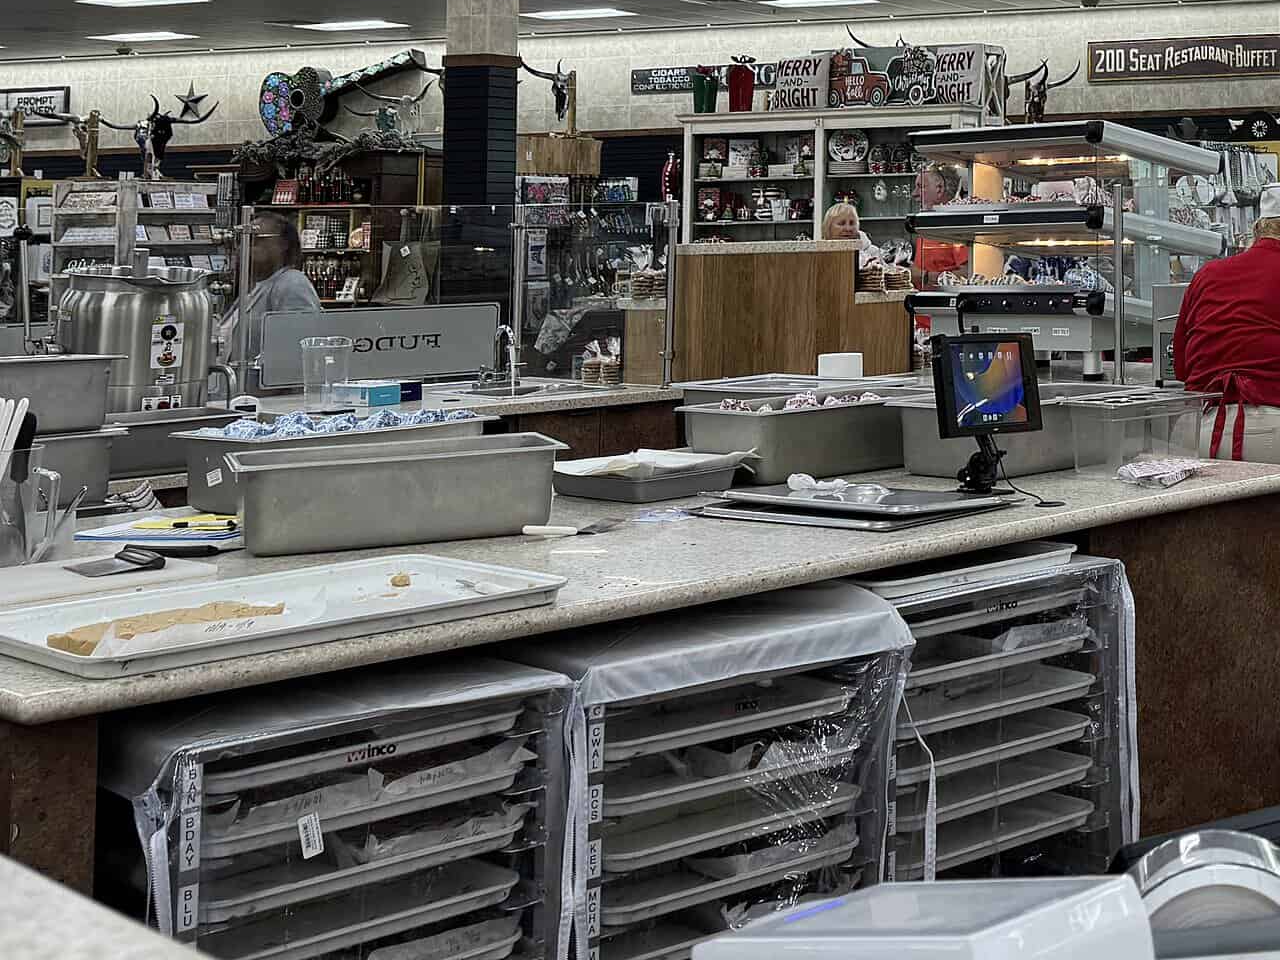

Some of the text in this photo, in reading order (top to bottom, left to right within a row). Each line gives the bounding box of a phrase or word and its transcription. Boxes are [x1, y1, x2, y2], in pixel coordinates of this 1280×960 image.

[777, 58, 823, 79] MERRY
[1094, 48, 1125, 73] 200
[1129, 47, 1162, 72] SEAT
[647, 75, 690, 84] TOBACCO
[651, 68, 687, 77] CIGARS
[845, 75, 865, 86] HELLO
[17, 95, 55, 107] PROMPT
[774, 87, 819, 109] BRIGHT
[936, 81, 973, 104] RIGHT
[185, 817, 196, 866] BDAY
[589, 843, 598, 875] KEY
[183, 890, 193, 927] BLU
